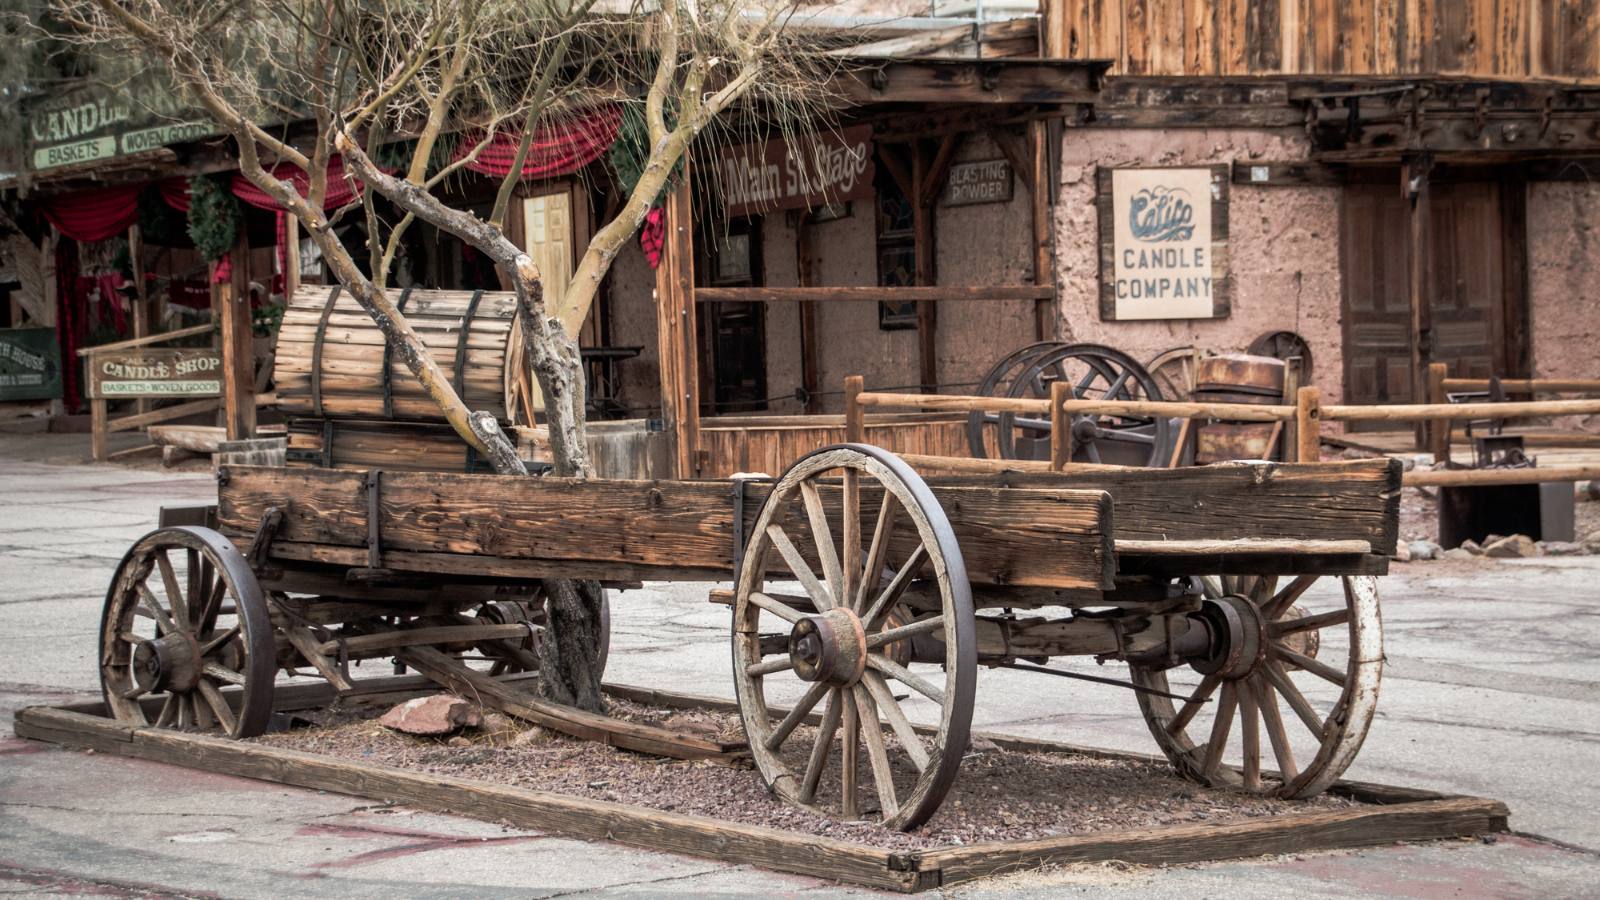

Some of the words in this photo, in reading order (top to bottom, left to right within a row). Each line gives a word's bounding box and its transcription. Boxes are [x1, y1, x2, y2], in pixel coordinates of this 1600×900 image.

[127, 130, 164, 150] WOVEN
[168, 122, 210, 141] GOODS
[49, 141, 100, 164] BASKETS
[726, 155, 782, 205] Main
[813, 141, 867, 192] Stage
[949, 163, 1006, 185] BLASTING
[952, 181, 1002, 200] POWDER
[1129, 185, 1195, 243] Calico
[1123, 248, 1204, 269] CANDLE
[1117, 277, 1211, 299] COMPANY
[103, 361, 170, 379] CANDLE
[175, 357, 220, 376] SHOP
[103, 383, 145, 392] BASKETS
[185, 382, 218, 392] GOODS
